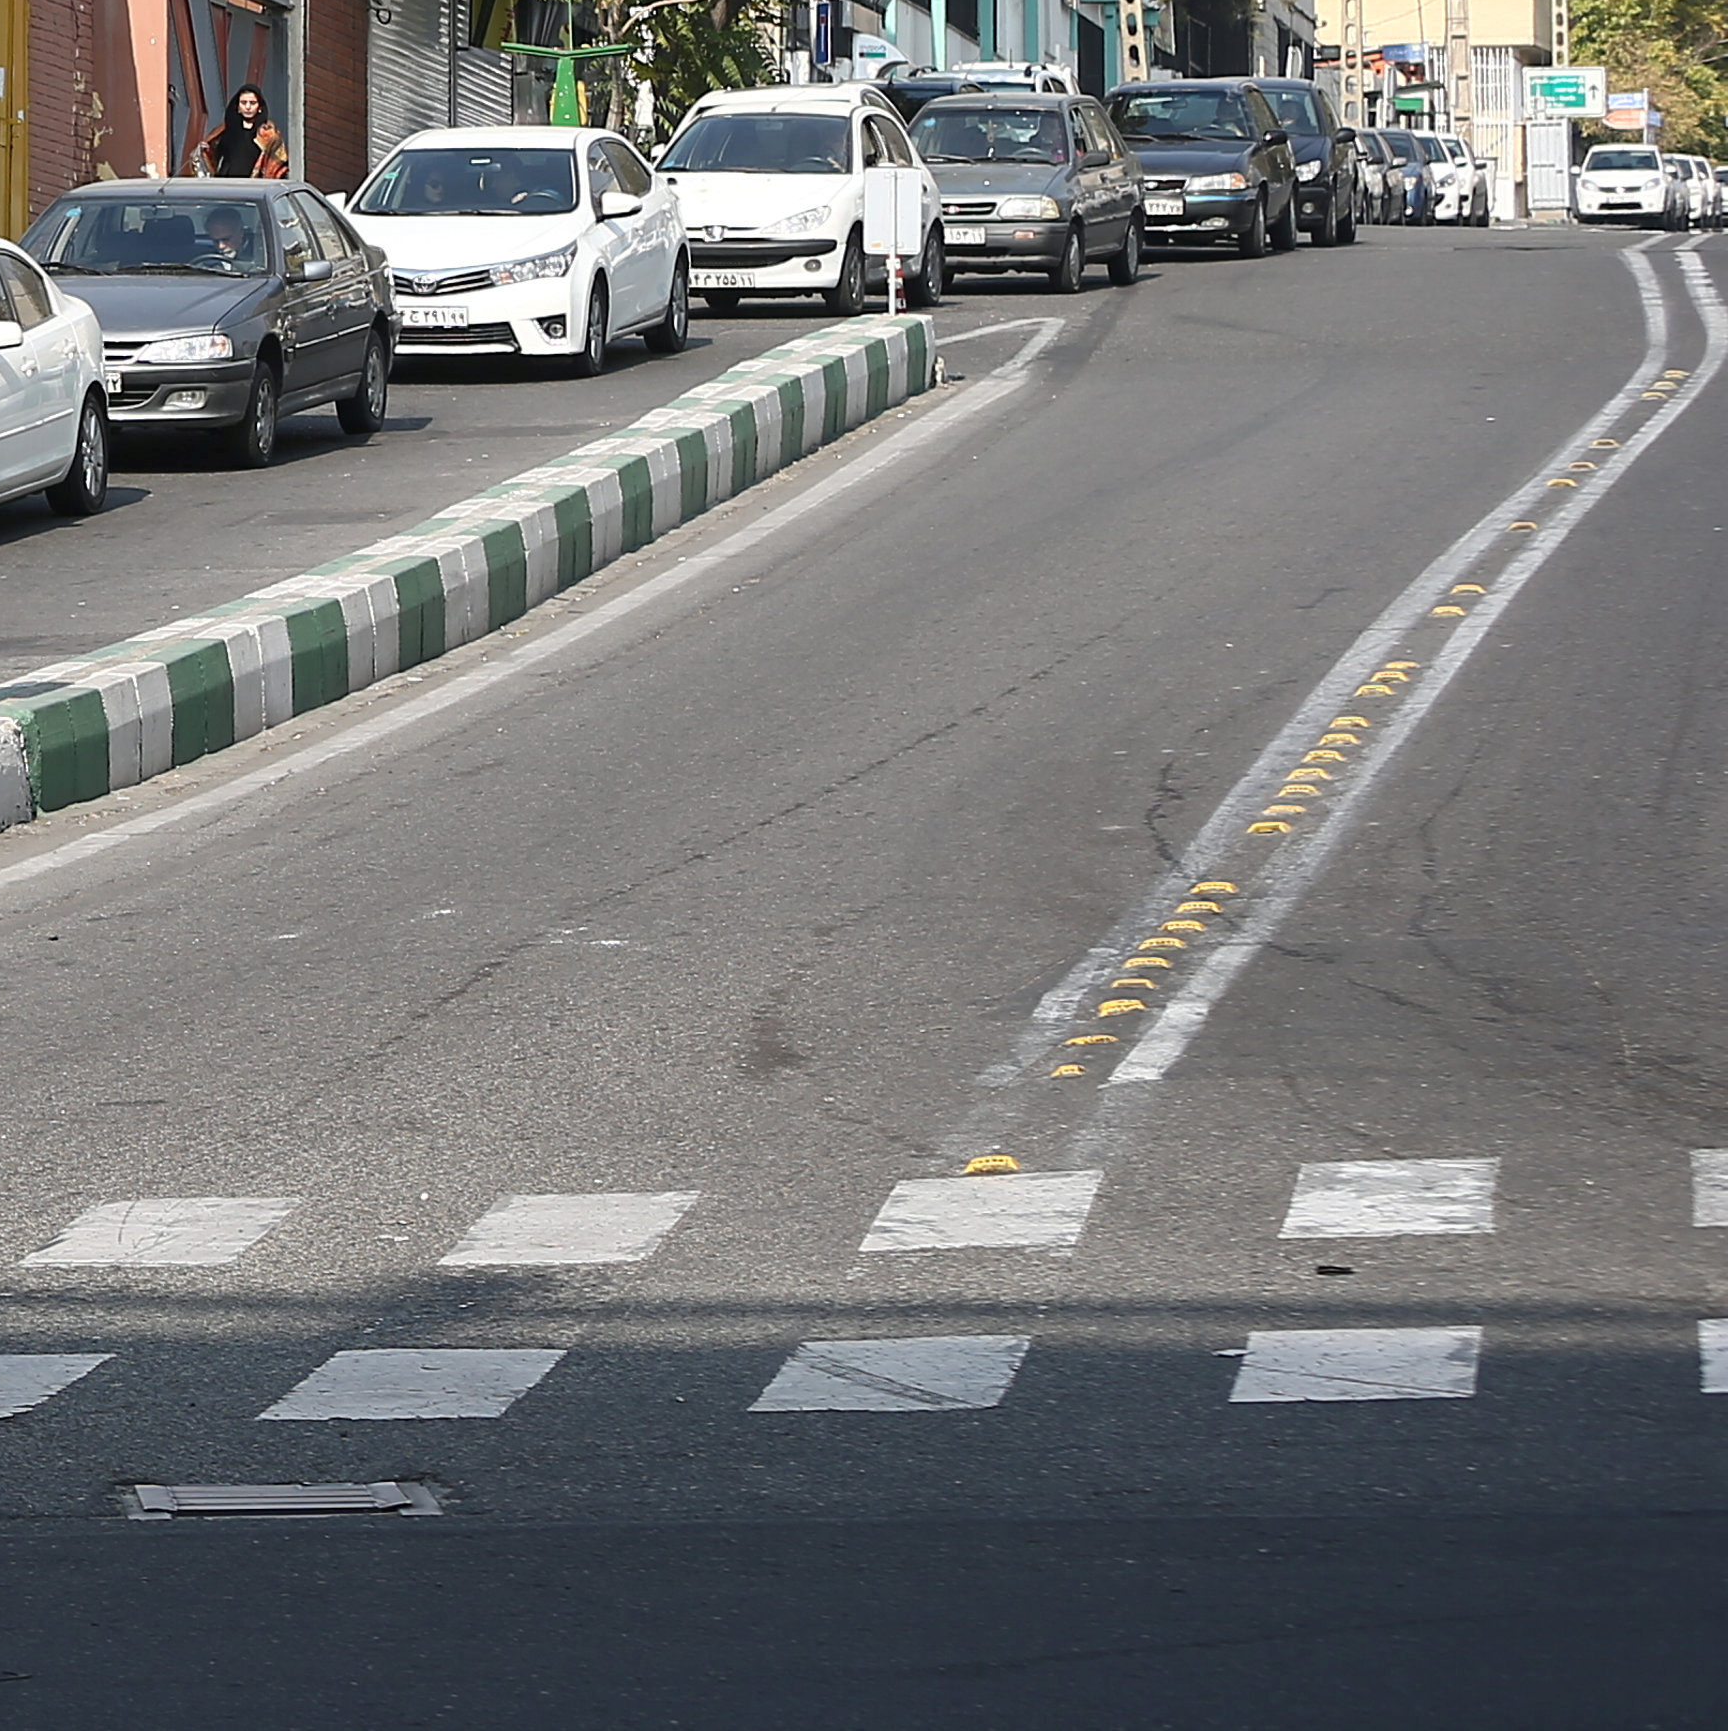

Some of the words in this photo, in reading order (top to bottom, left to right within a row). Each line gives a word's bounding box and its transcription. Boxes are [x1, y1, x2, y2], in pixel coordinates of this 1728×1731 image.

[715, 273, 737, 286] ۲۵۵
[740, 276, 752, 286] ۱۱
[424, 309, 447, 324] ۲۹۱
[450, 312, 465, 325] ۹۹
